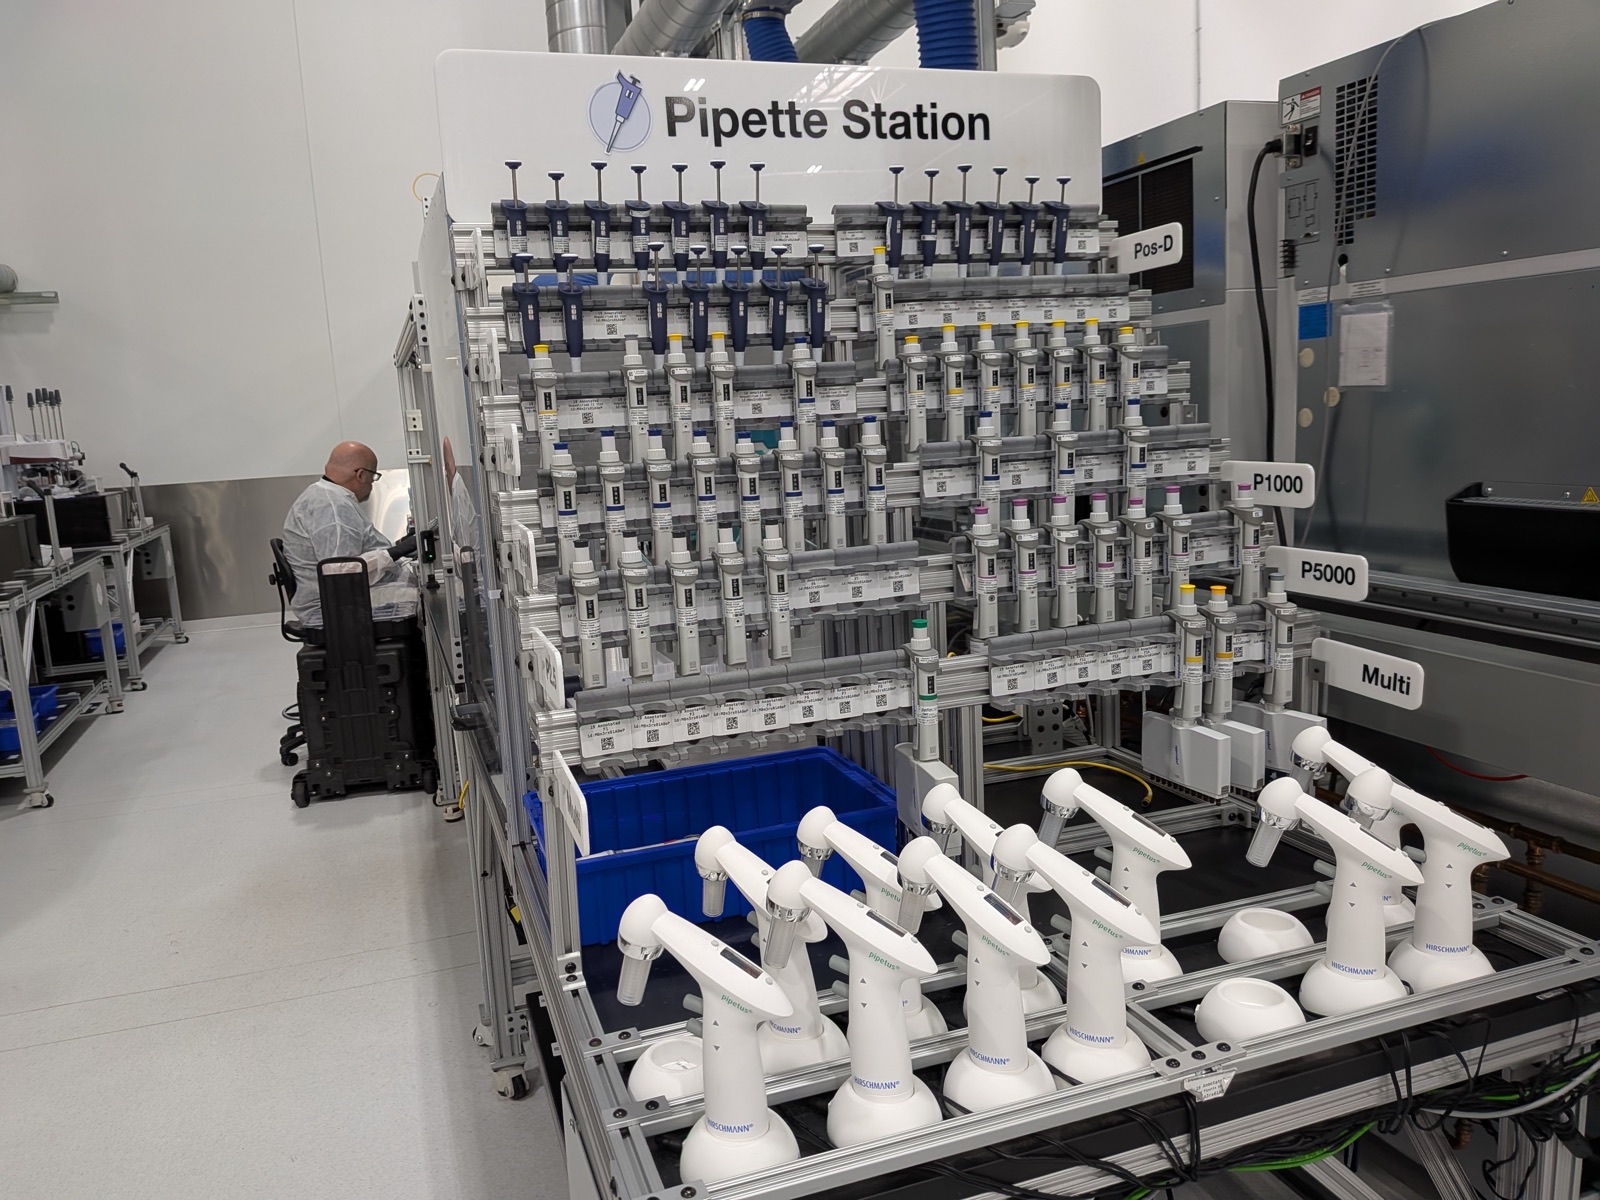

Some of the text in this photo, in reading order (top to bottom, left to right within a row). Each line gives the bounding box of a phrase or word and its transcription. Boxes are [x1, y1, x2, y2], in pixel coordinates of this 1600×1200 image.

[665, 96, 991, 147] Pipette Station
[1134, 234, 1174, 260] Pos-D
[1253, 473, 1303, 494] P1000
[1301, 561, 1356, 586] P5000
[1362, 663, 1411, 696] Multi
